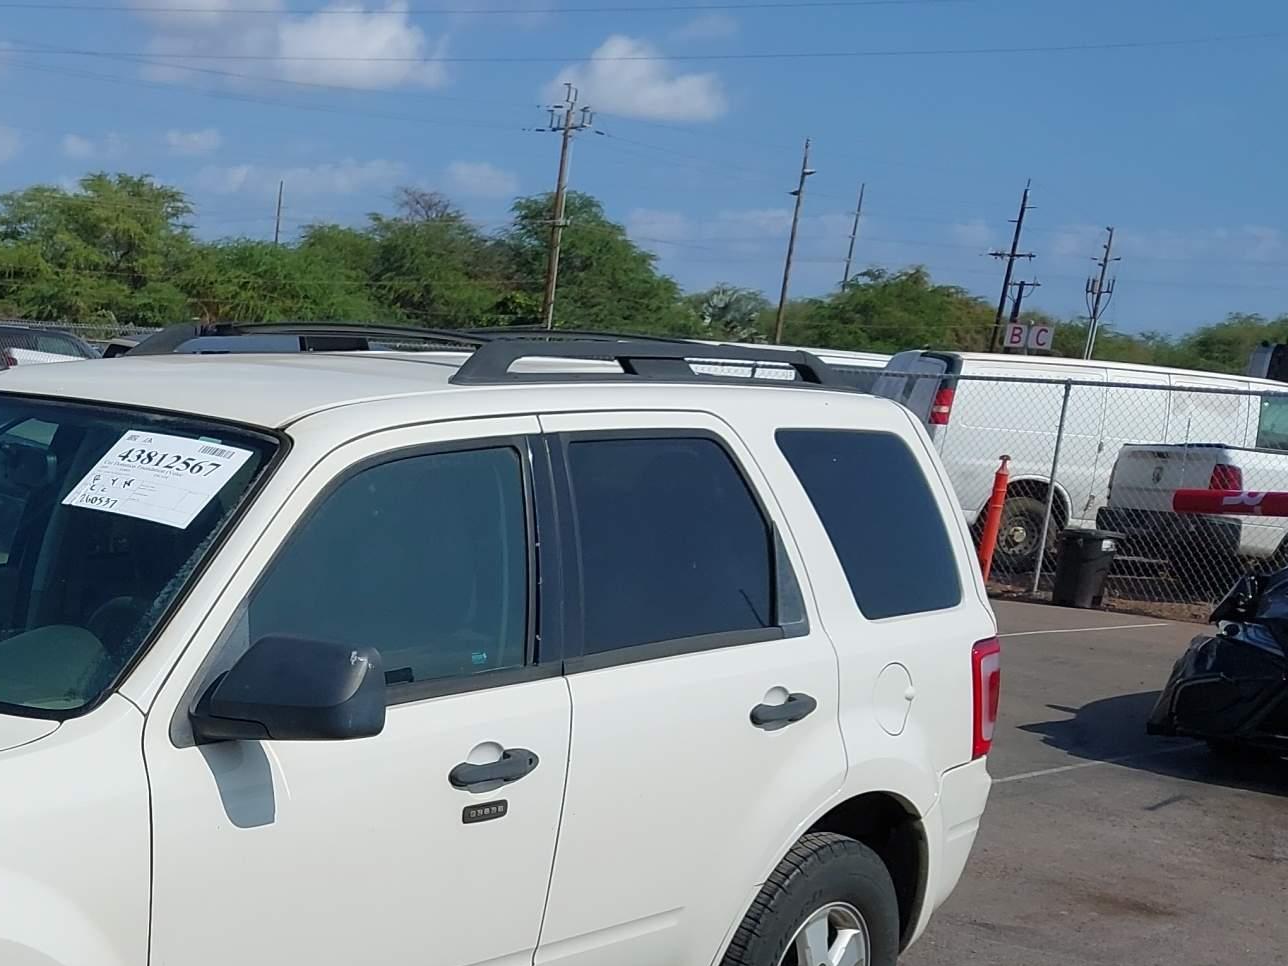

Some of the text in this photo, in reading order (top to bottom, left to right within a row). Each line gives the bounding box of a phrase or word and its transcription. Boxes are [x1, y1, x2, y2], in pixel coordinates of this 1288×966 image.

[1010, 326, 1049, 346] B C
[117, 447, 222, 477] 43812567
